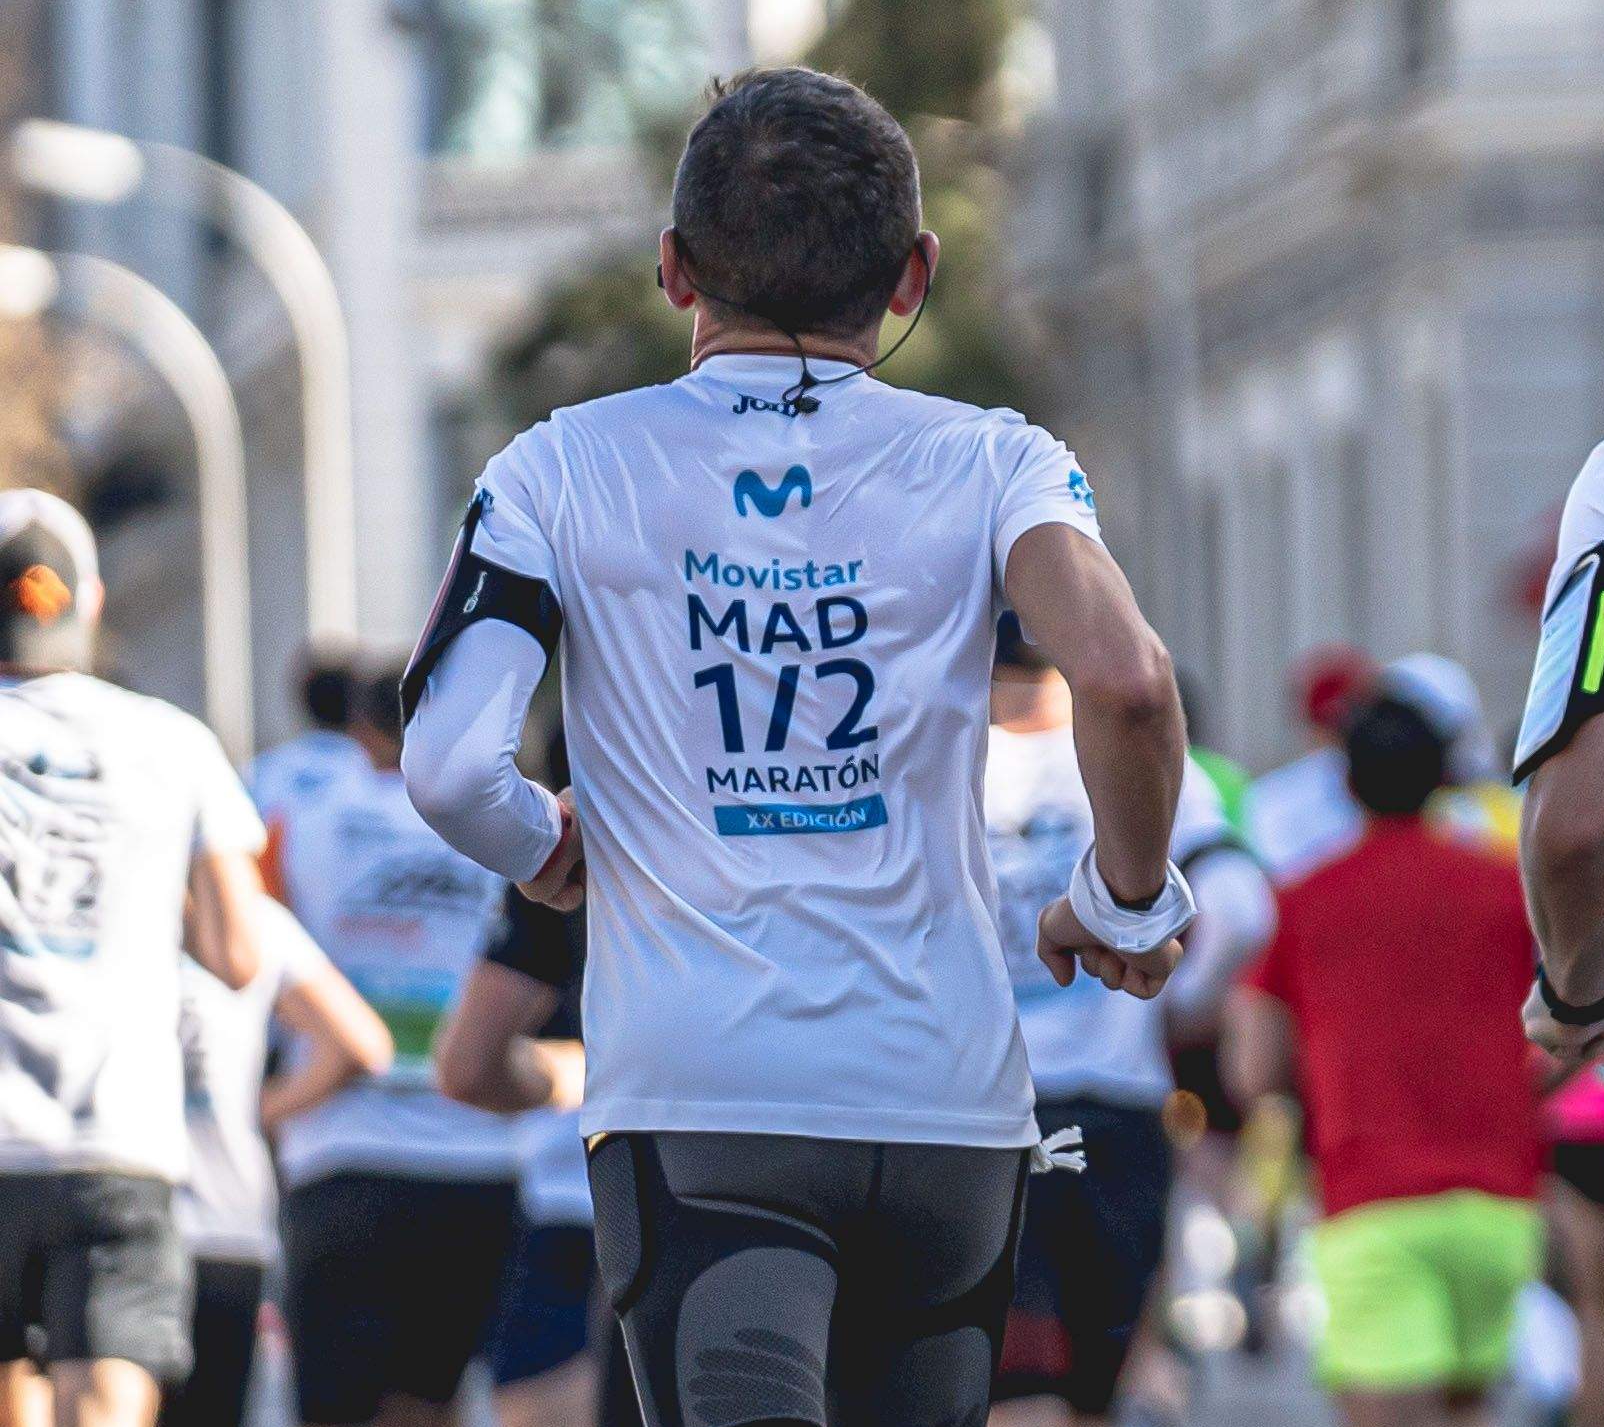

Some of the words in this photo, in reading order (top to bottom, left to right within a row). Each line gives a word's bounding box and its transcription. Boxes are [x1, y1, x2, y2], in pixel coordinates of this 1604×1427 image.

[733, 392, 820, 418] Jom
[684, 550, 864, 591] Movistar
[688, 594, 869, 655] MAD
[694, 658, 880, 755] 1/2
[707, 753, 881, 795] MARATÓN
[780, 807, 867, 828] EDICIÓN
